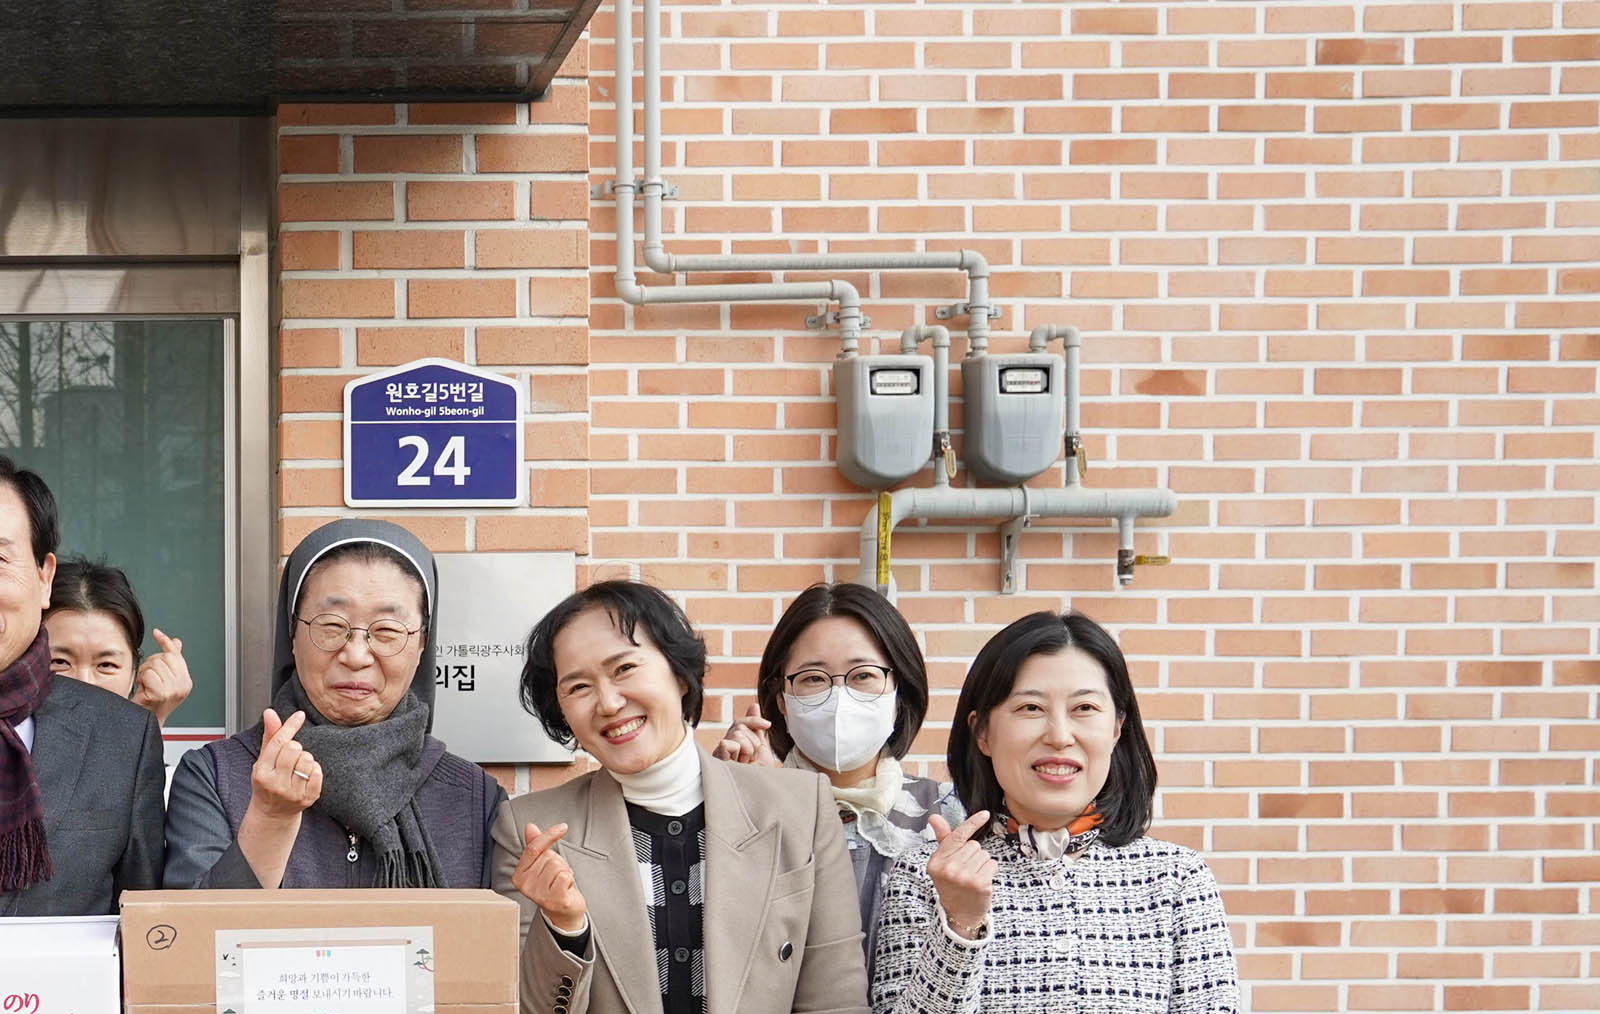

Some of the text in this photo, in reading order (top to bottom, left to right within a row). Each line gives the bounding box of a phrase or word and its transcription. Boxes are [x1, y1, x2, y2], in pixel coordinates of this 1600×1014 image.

[386, 382, 484, 402] 원호길5번길
[386, 406, 484, 418] Wonho-gil 5beon-gil
[397, 435, 471, 486] 24
[446, 644, 528, 658] 가톨릭광주사회
[436, 664, 475, 692] 의집
[280, 971, 371, 984] 희망과 기쁨이 가득한
[3, 992, 40, 1014] のり
[256, 989, 286, 1001] 즐거운
[290, 988, 310, 1000] 명절
[312, 988, 350, 1000] 보내시기
